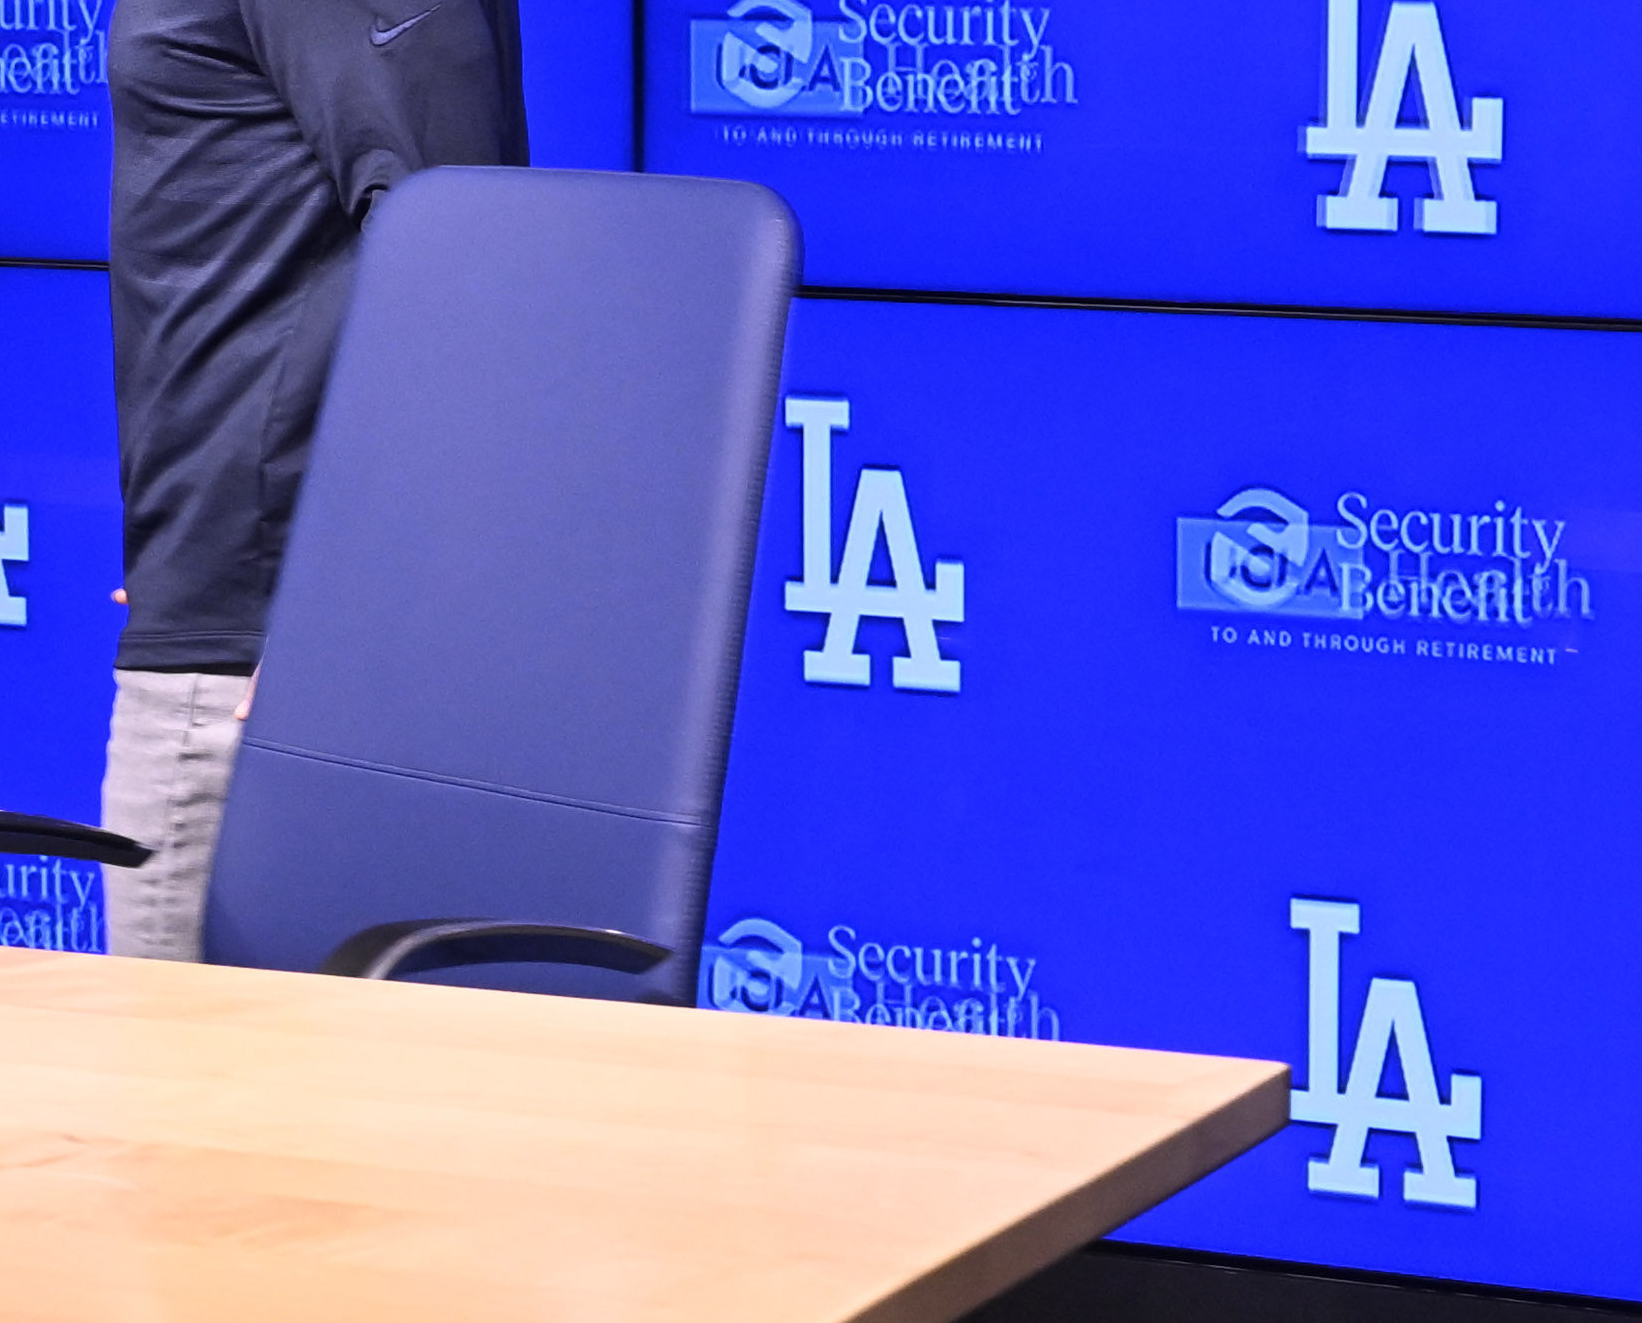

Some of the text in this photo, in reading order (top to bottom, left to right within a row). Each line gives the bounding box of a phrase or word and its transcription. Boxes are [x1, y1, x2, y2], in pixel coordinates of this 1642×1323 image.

[839, 56, 1022, 116] Benefit
[784, 398, 965, 692] LA
[1337, 494, 1564, 567] Security
[1338, 559, 1534, 627] Benefit
[1212, 626, 1557, 668] TO AND THROUGH RETIREMENT
[828, 926, 1036, 1000] Security
[1290, 899, 1482, 1208] LA
